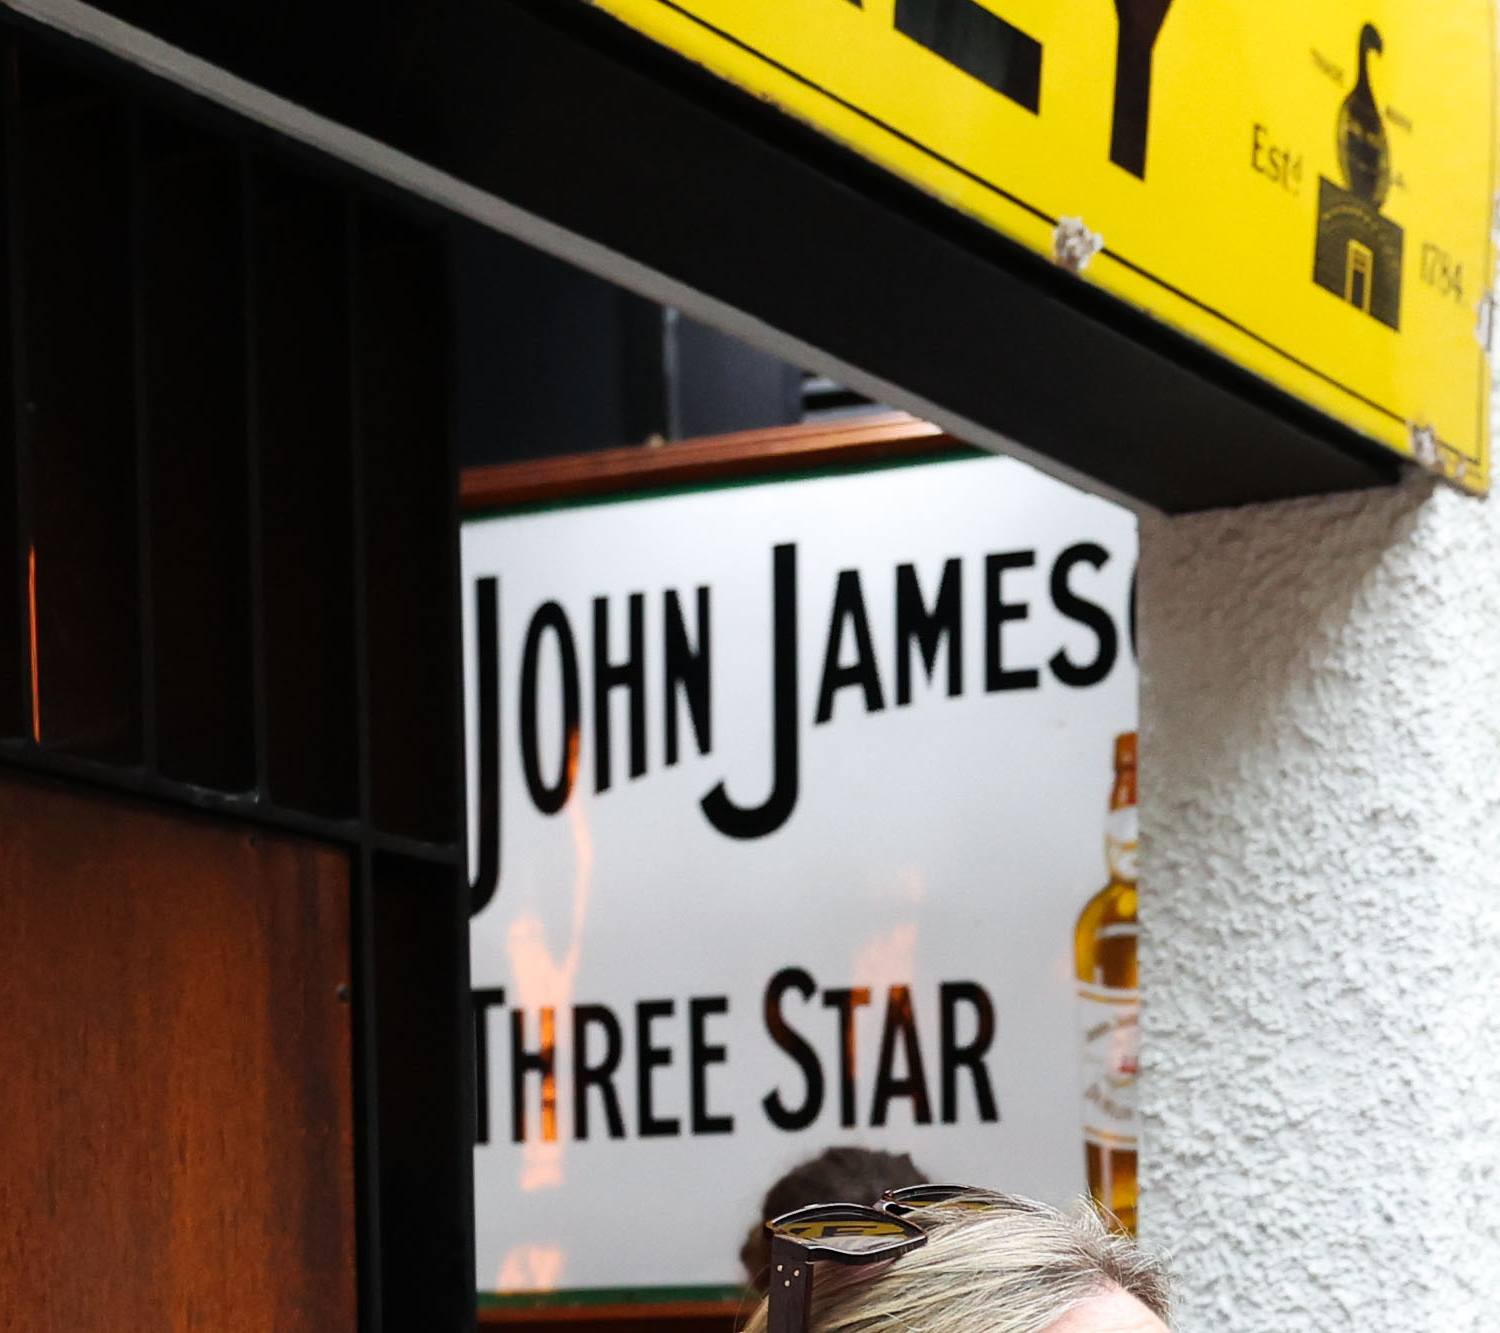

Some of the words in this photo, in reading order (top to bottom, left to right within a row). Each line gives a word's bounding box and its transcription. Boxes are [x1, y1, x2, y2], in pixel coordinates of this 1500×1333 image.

[468, 576, 712, 918] JOHN
[700, 542, 1138, 842] JAMES
[473, 984, 734, 1144] THREE
[762, 966, 999, 1132] STAR
